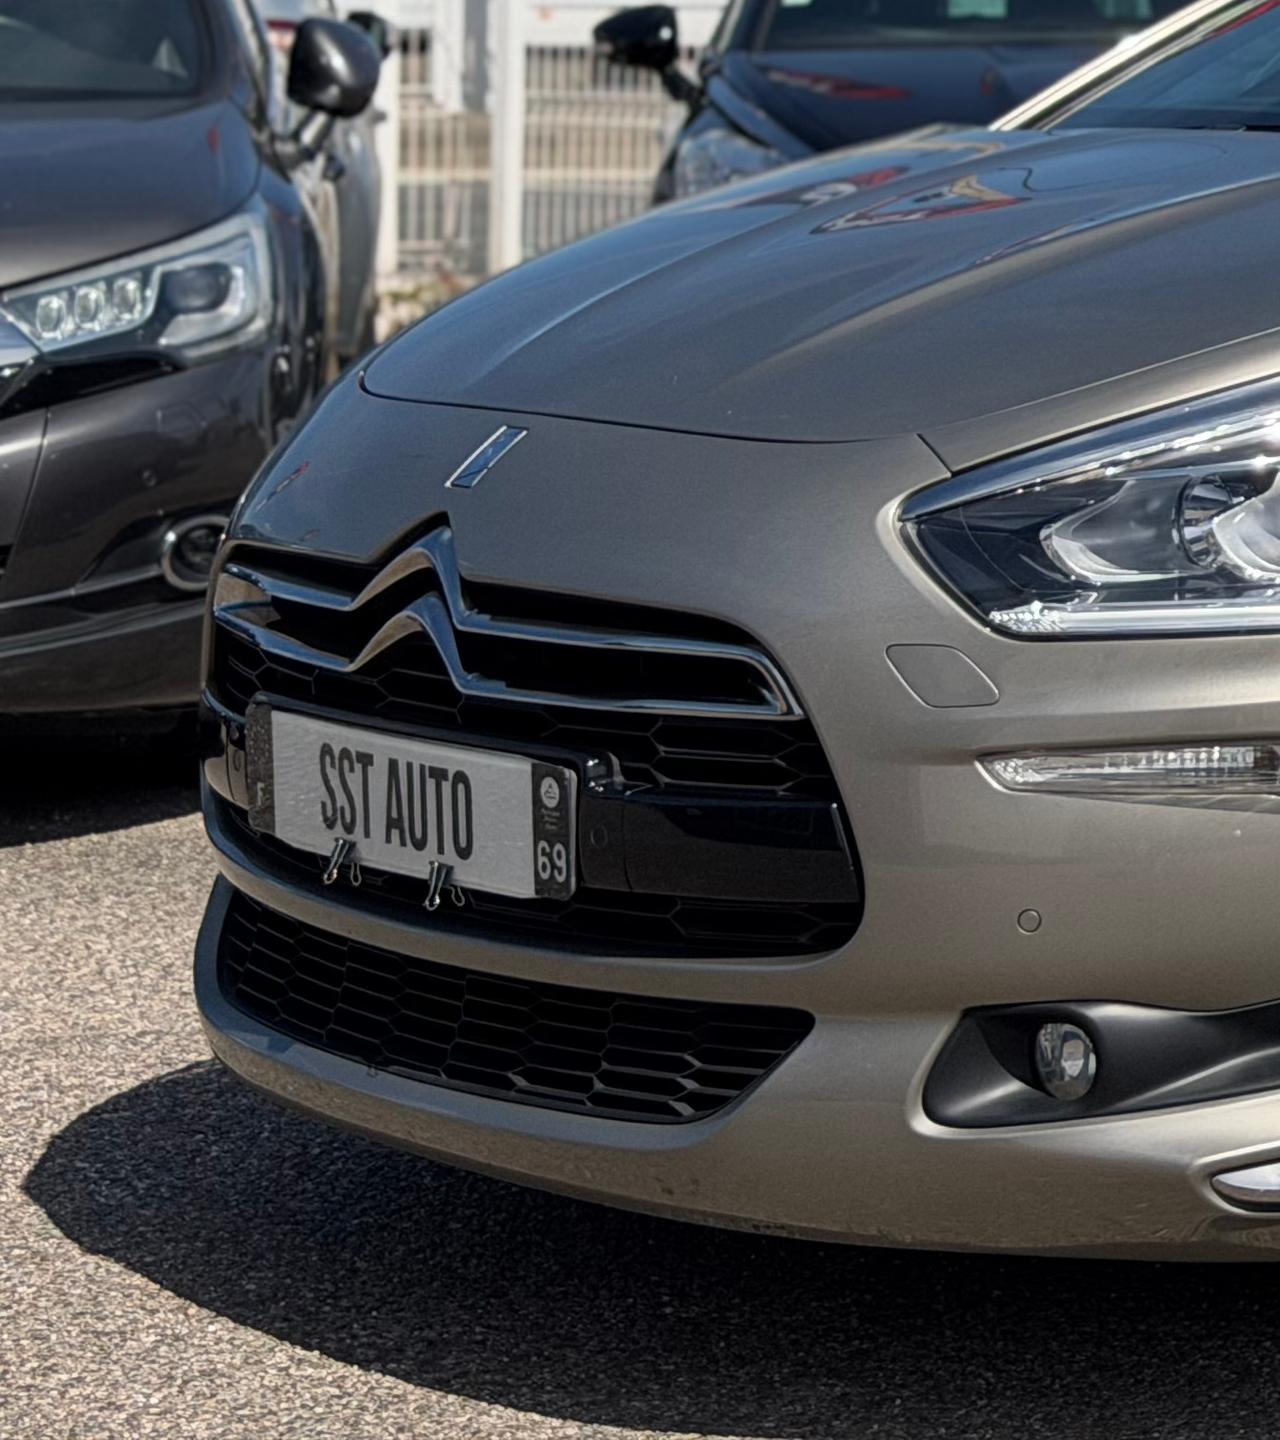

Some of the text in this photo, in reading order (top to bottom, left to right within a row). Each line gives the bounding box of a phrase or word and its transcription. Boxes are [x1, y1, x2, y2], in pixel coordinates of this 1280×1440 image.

[319, 741, 473, 860] SST AUTO
[537, 840, 567, 883] 69
